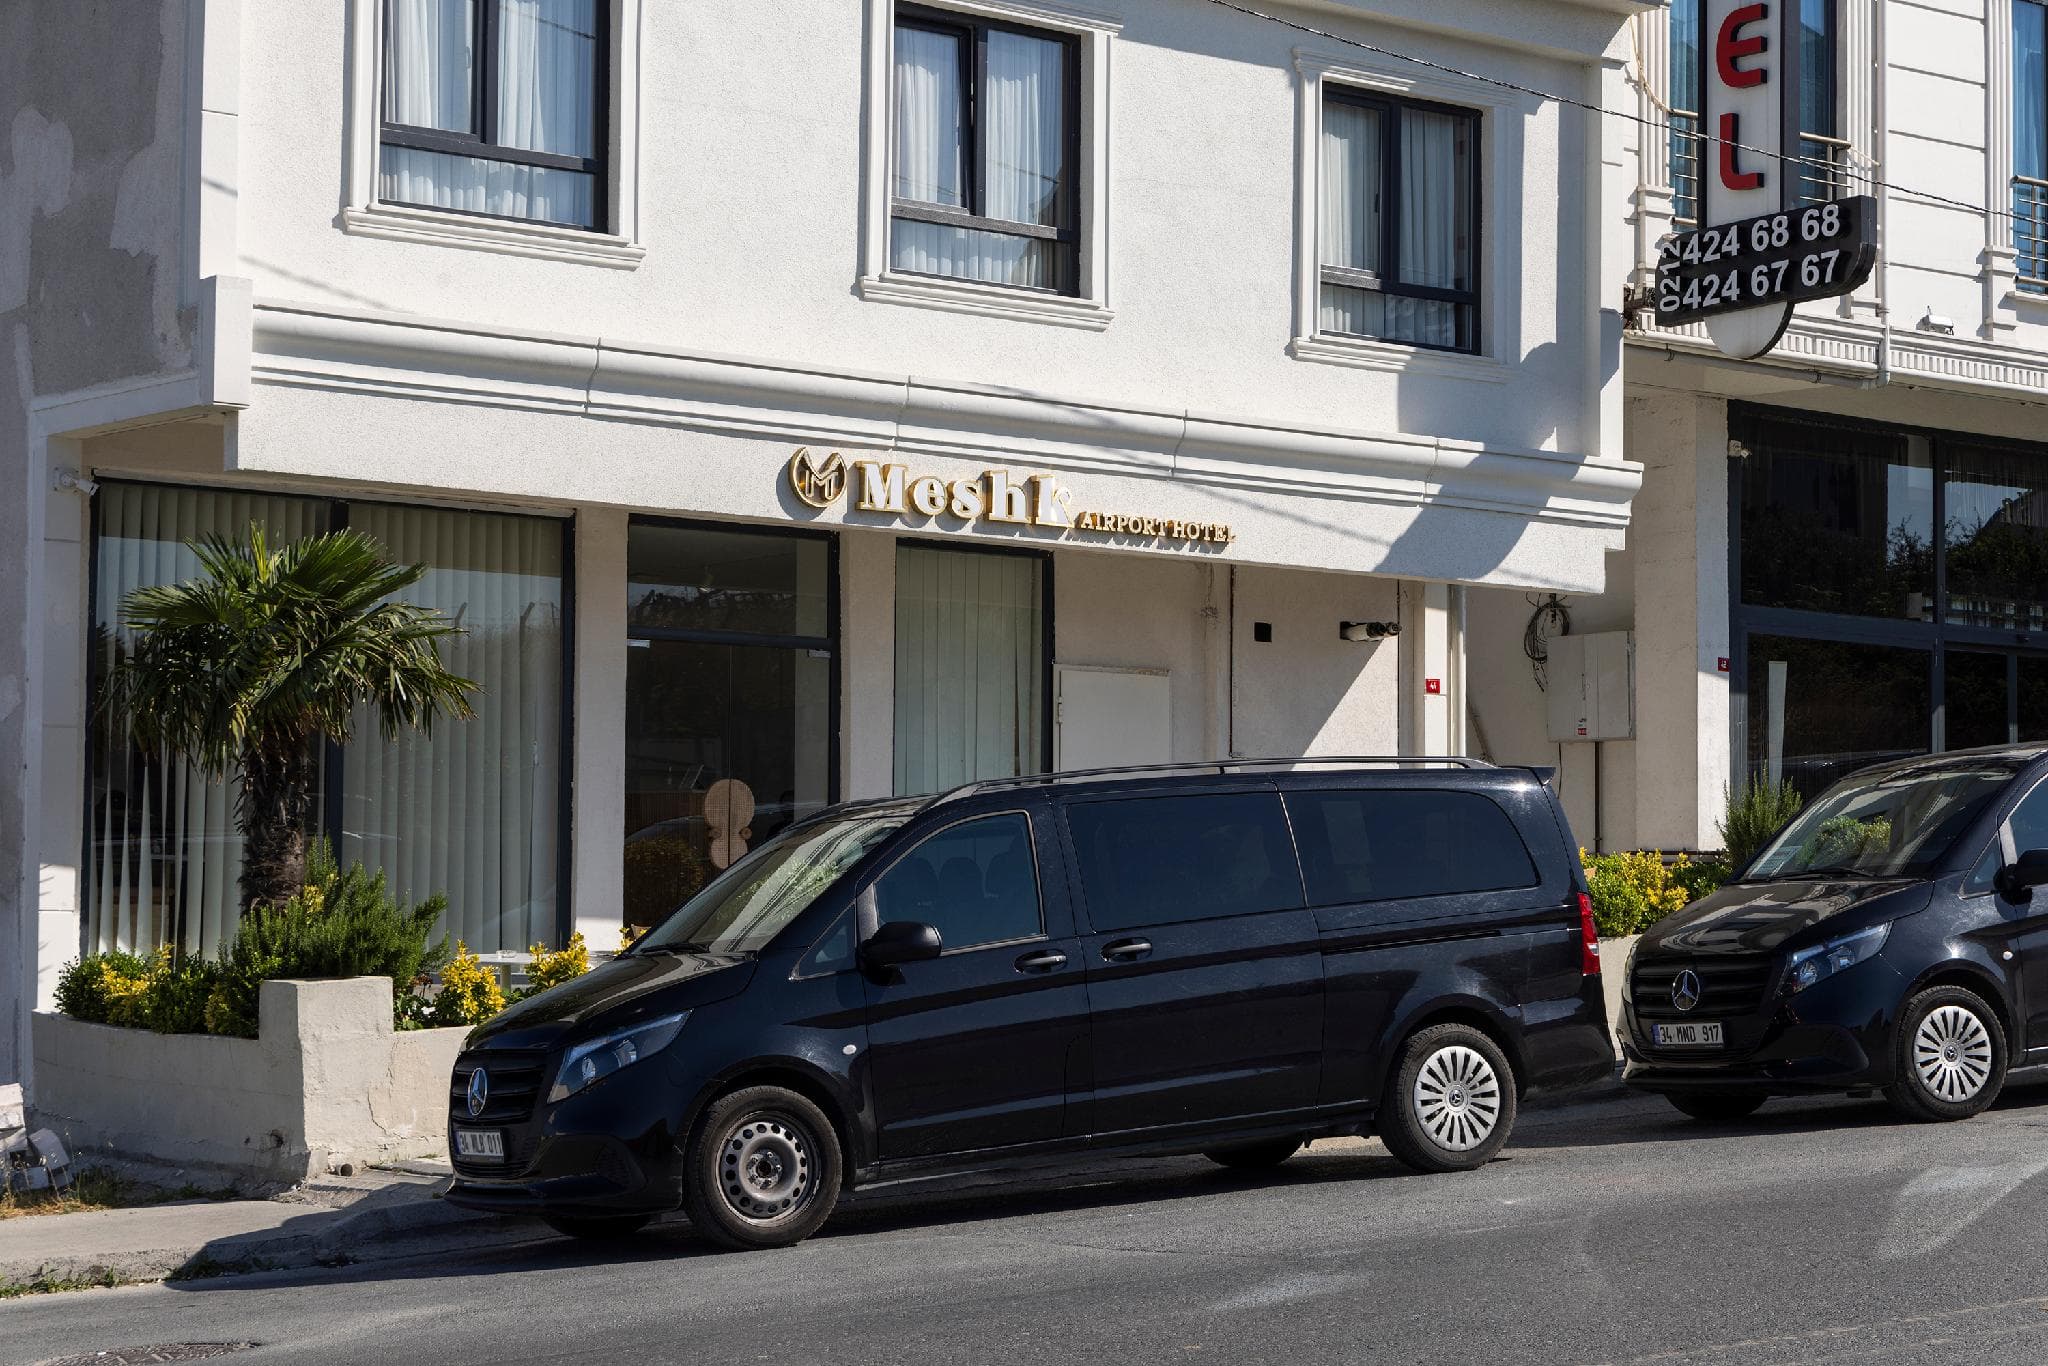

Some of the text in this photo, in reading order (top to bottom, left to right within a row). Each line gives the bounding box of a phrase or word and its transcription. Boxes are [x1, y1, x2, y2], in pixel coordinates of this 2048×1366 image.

[1682, 204, 1840, 265] 424 68 68
[1659, 240, 1681, 312] 0212
[1682, 249, 1840, 310] 424 67 67
[855, 460, 1237, 543] Meshk AIRPORT HOTEL
[1659, 1026, 1672, 1043] 34
[1702, 1024, 1719, 1042] 917
